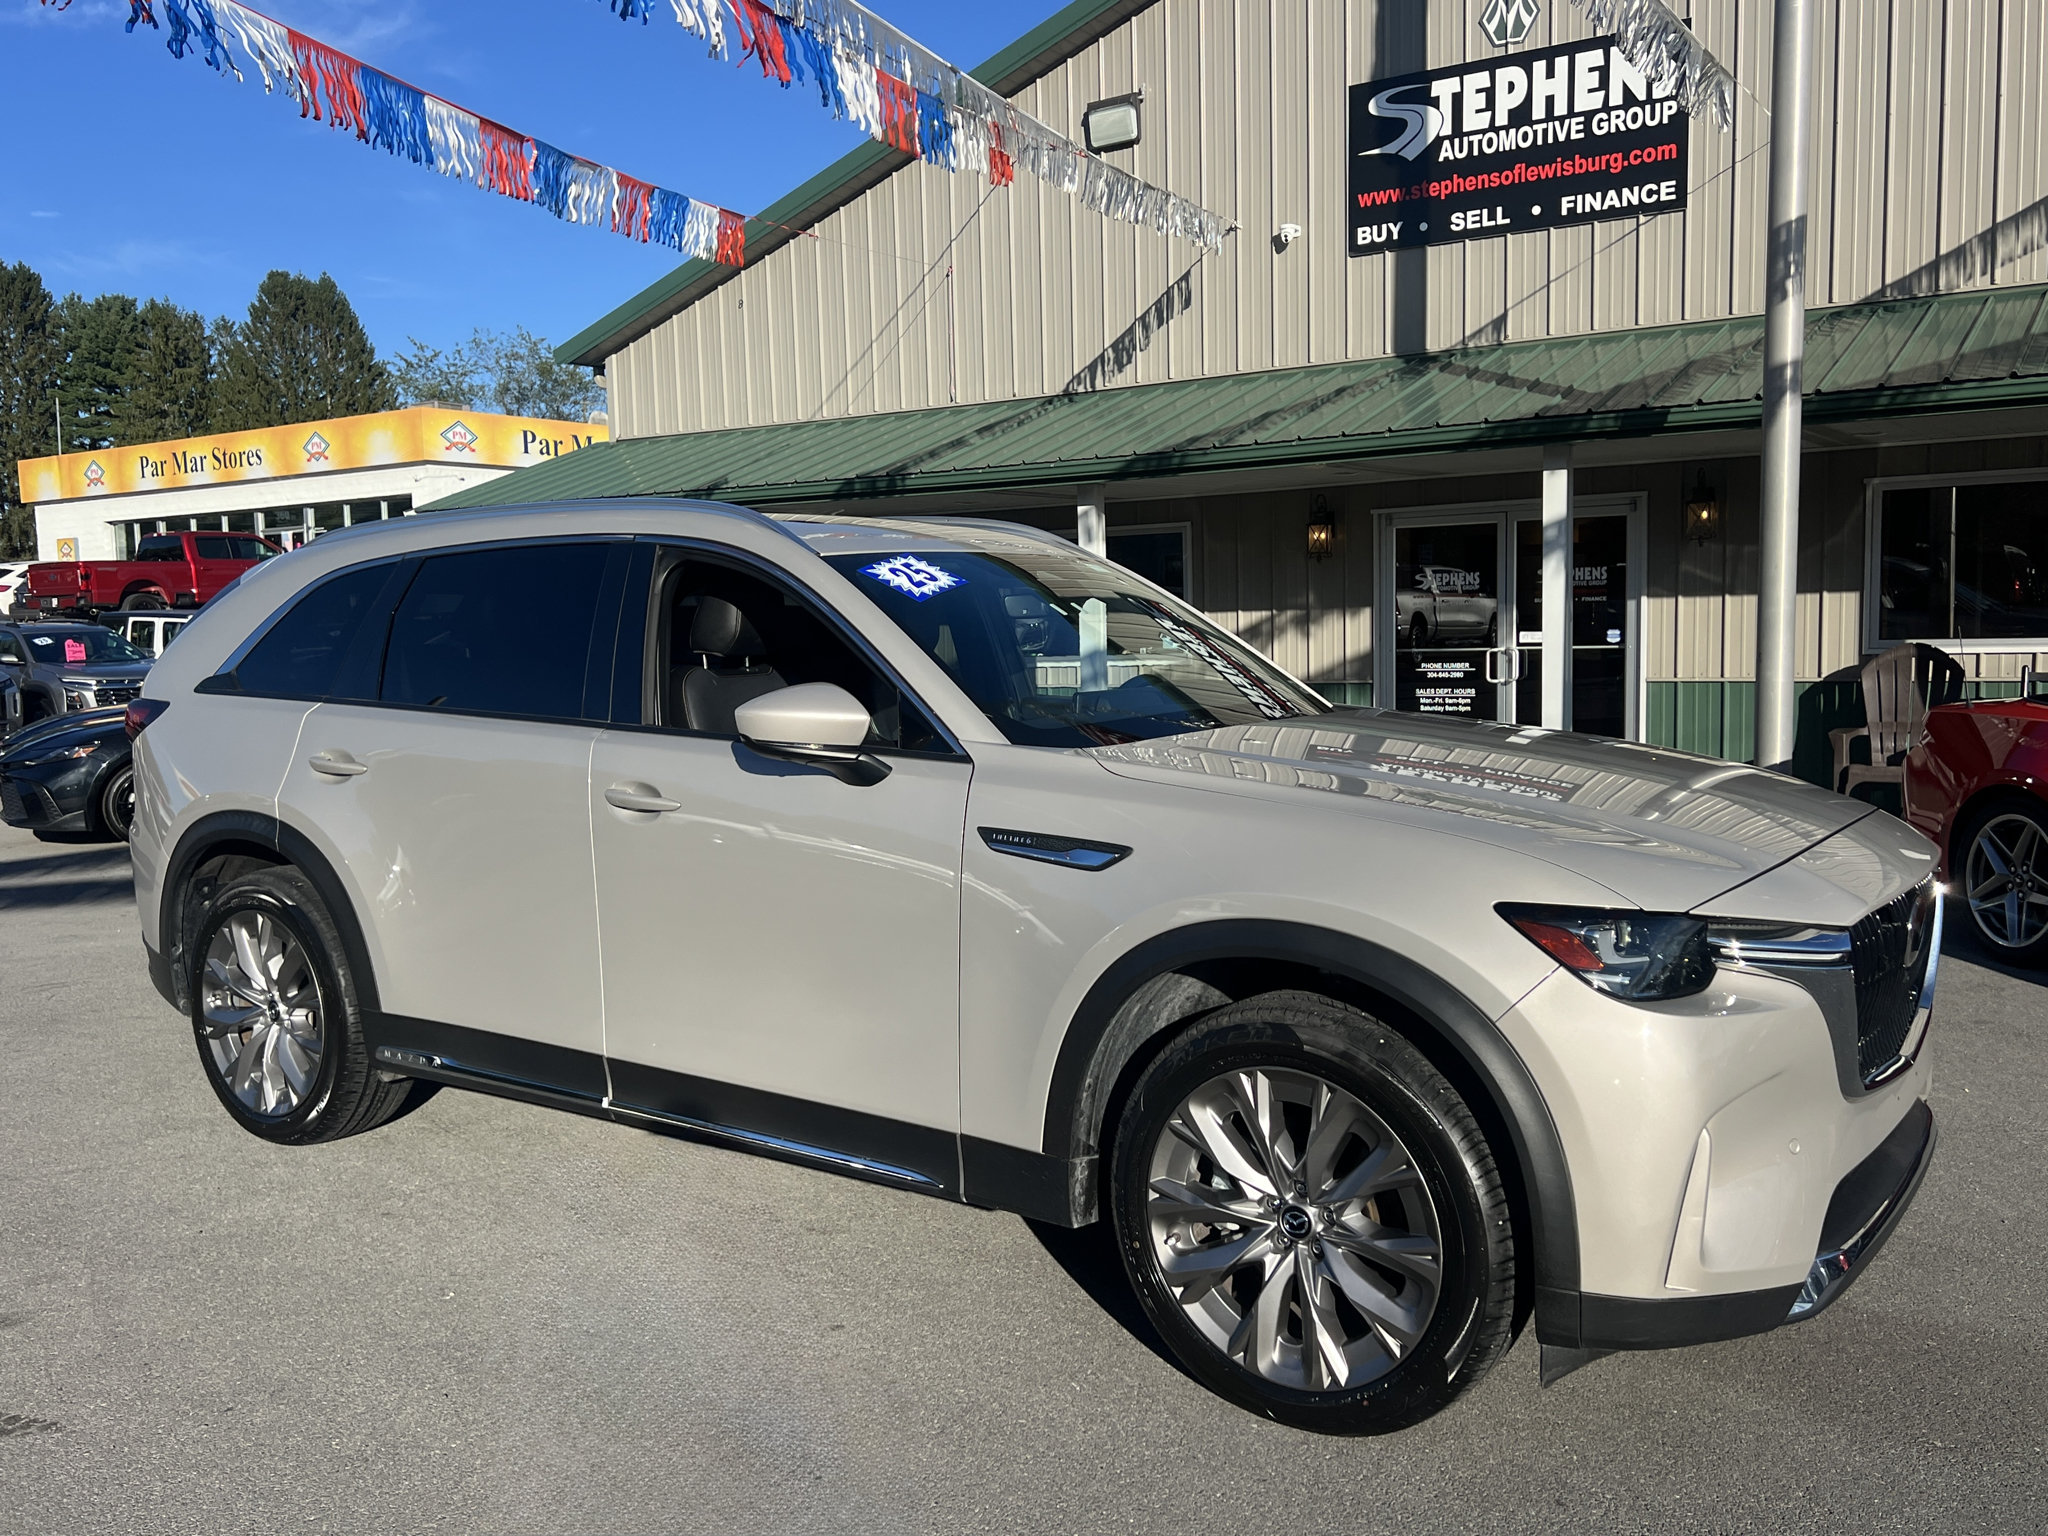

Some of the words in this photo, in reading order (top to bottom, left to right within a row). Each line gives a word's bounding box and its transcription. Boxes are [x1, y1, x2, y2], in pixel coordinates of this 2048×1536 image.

[1437, 116, 1585, 163] AUTOMOTIVE
[1591, 99, 1679, 136] GROUP
[1357, 143, 1678, 209] www.stephensoflewisburg.com
[1356, 221, 1404, 246] BUY
[1450, 206, 1511, 232] SELL
[1560, 180, 1678, 217] FINANCE
[452, 430, 467, 441] PM
[520, 428, 564, 457] Par
[139, 455, 167, 479] Par
[172, 450, 207, 476] Mar
[212, 446, 263, 472] Stores
[887, 561, 939, 589] 25
[384, 1049, 438, 1067] MAZDA
